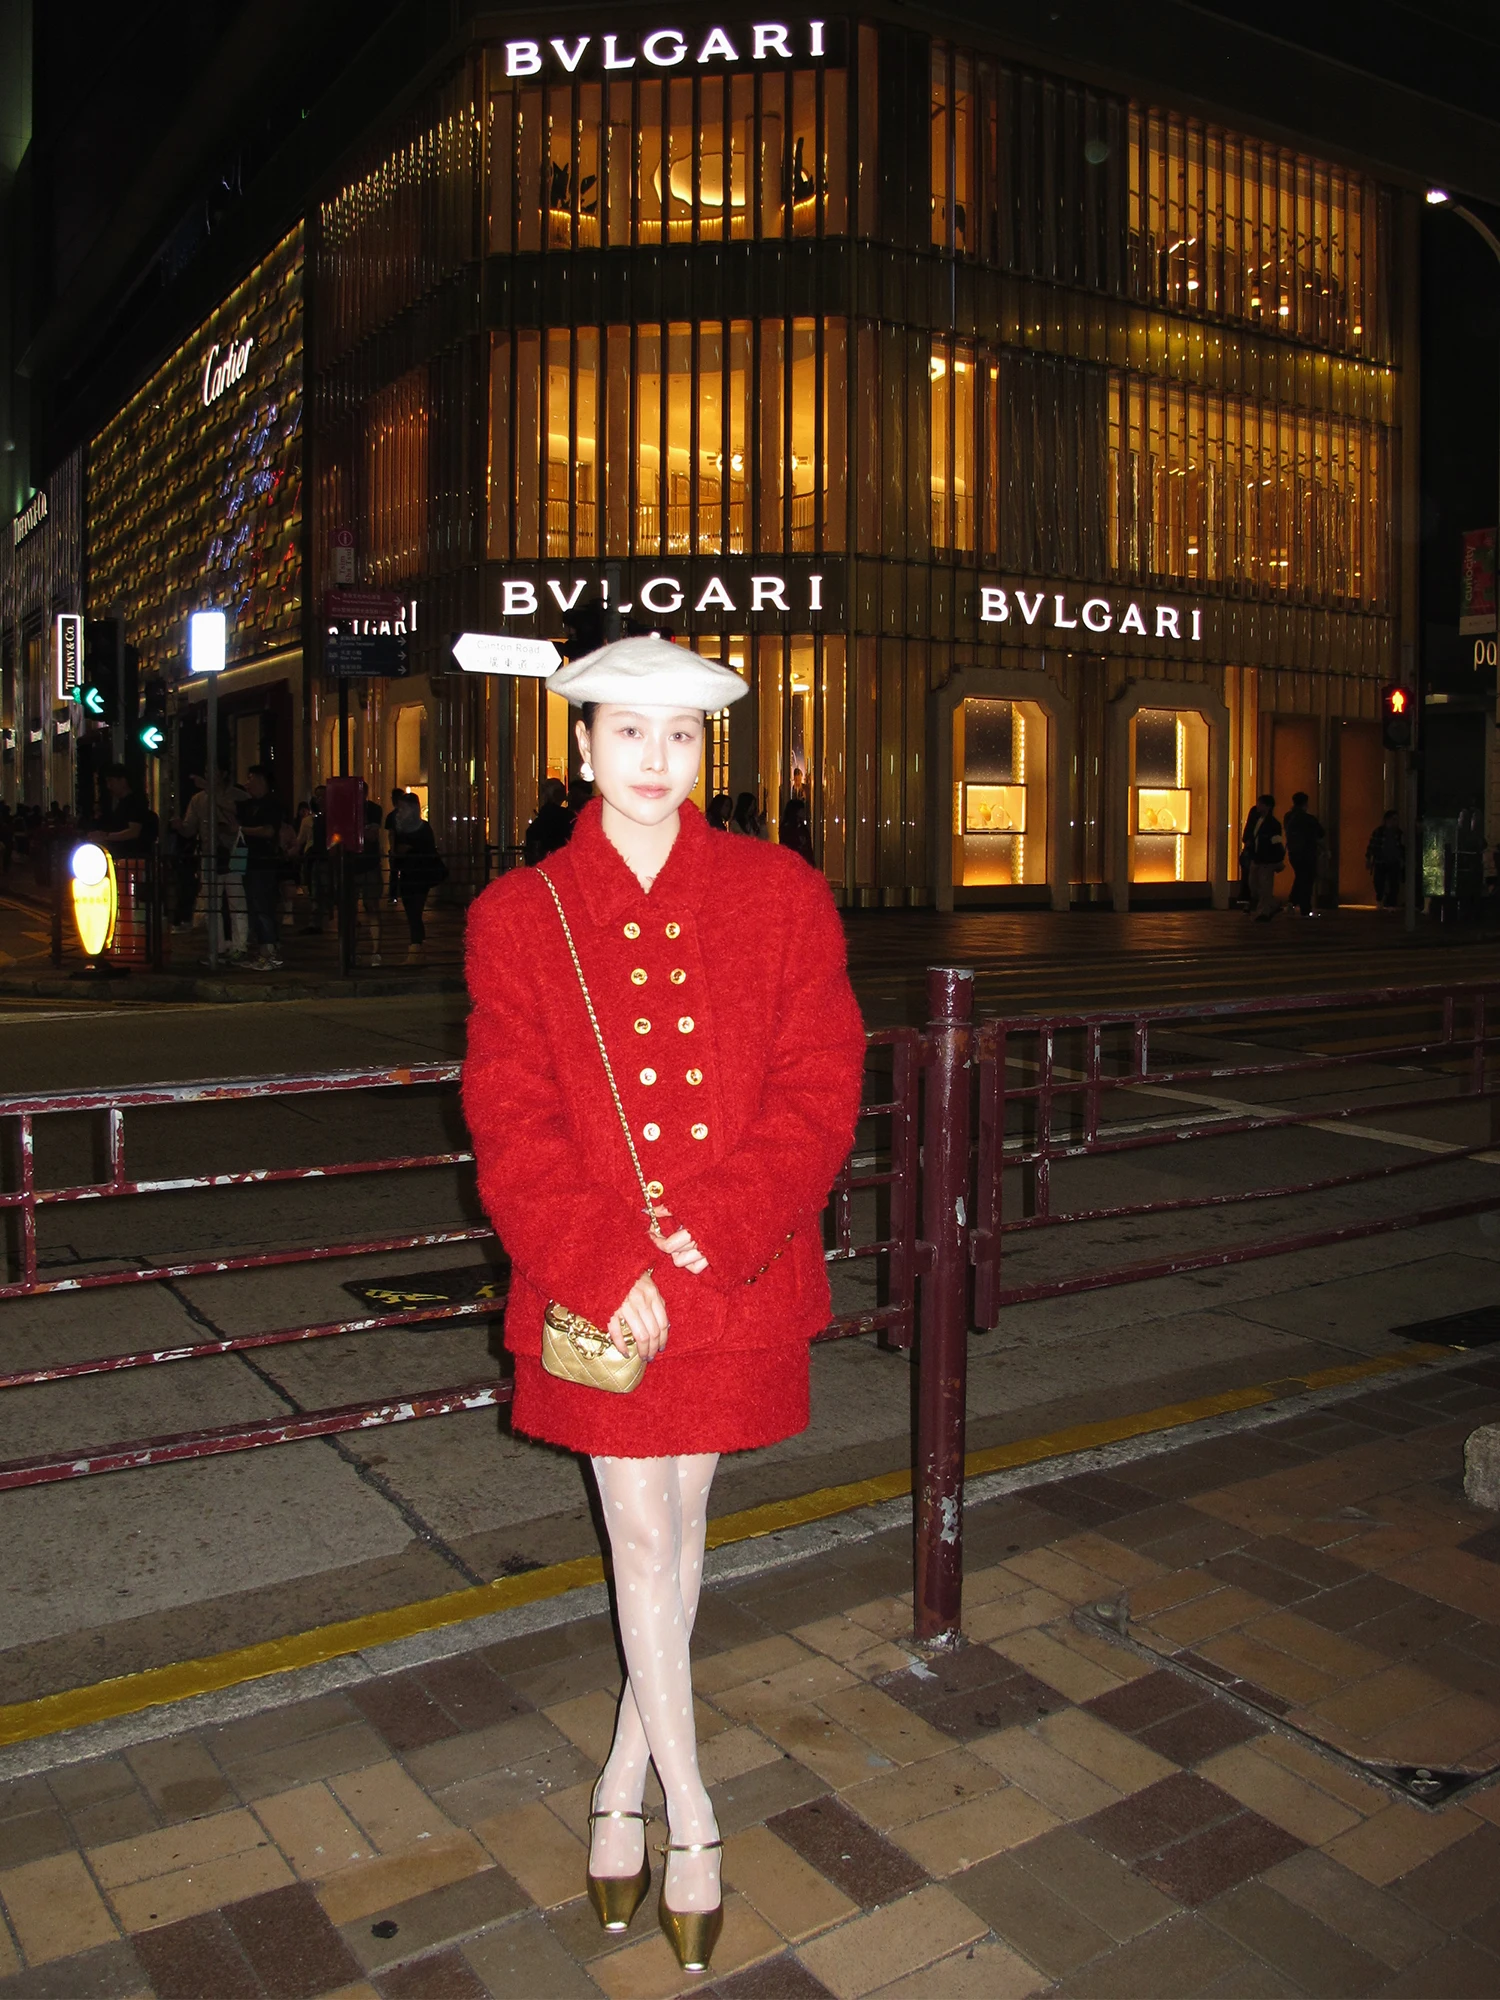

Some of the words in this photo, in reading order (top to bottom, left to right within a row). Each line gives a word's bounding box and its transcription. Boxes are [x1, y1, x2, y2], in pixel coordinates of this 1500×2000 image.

[505, 21, 825, 77] BVLGARI
[203, 337, 254, 407] Cartier
[980, 587, 1201, 641] BVLGARI
[515, 643, 541, 655] Road
